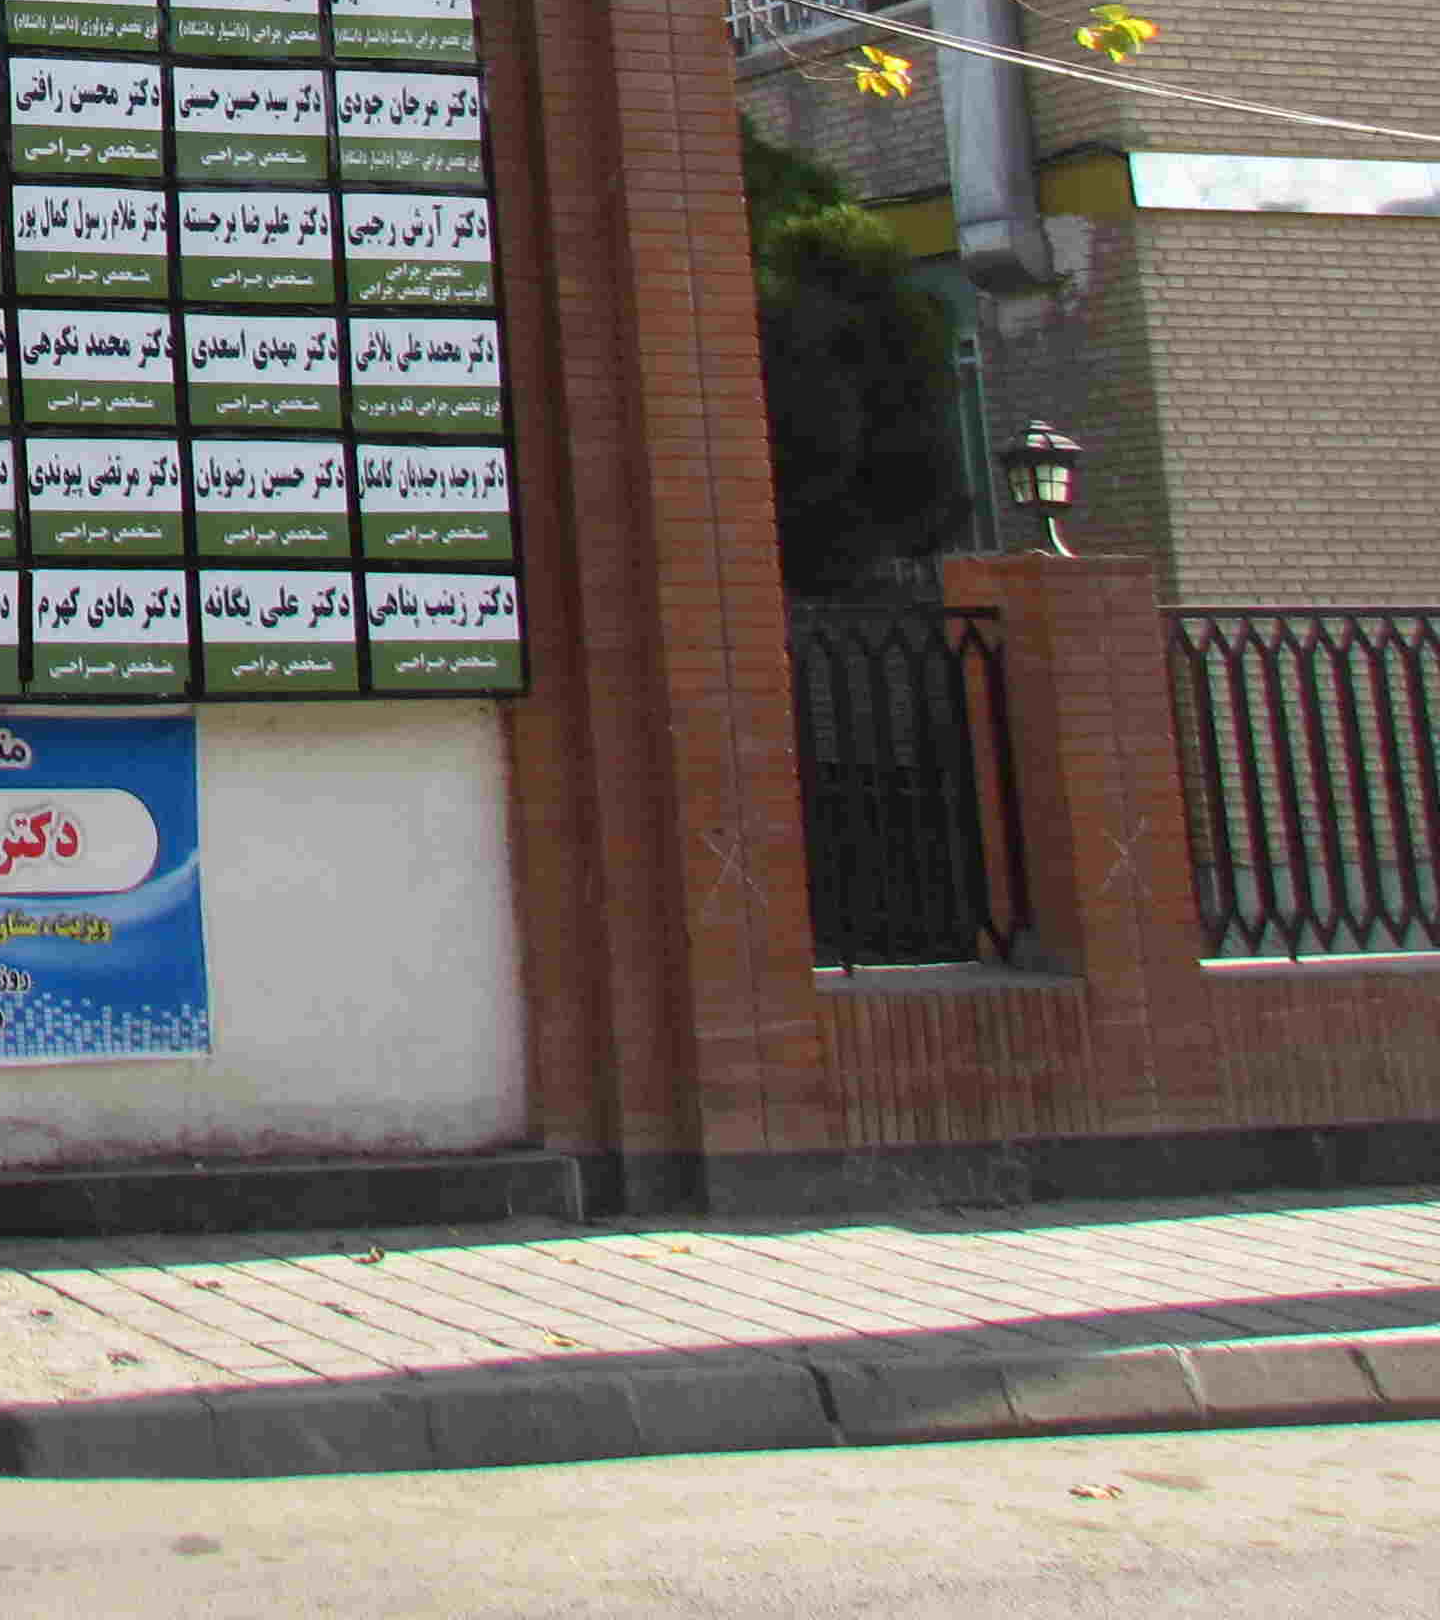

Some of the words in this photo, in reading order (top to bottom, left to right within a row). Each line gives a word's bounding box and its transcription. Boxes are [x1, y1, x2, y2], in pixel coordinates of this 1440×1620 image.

[71, 83, 118, 113] محسن
[126, 78, 161, 116] دکتر
[295, 85, 321, 122] دکتر
[445, 89, 477, 126] دکتر
[142, 203, 168, 241] دکتر
[298, 207, 329, 246] دکتر
[452, 209, 487, 247] دکتر
[86, 329, 131, 356] محمد
[139, 329, 175, 367] دکتر
[304, 332, 337, 371] دکتر
[468, 334, 494, 371] دکتر
[146, 456, 179, 497] دکتر
[313, 458, 345, 498] دکتر
[87, 588, 135, 627] هادی
[142, 586, 181, 629] دکتر
[260, 584, 299, 628] علی
[309, 587, 350, 628] دکتر
[475, 584, 513, 627] دکتر
